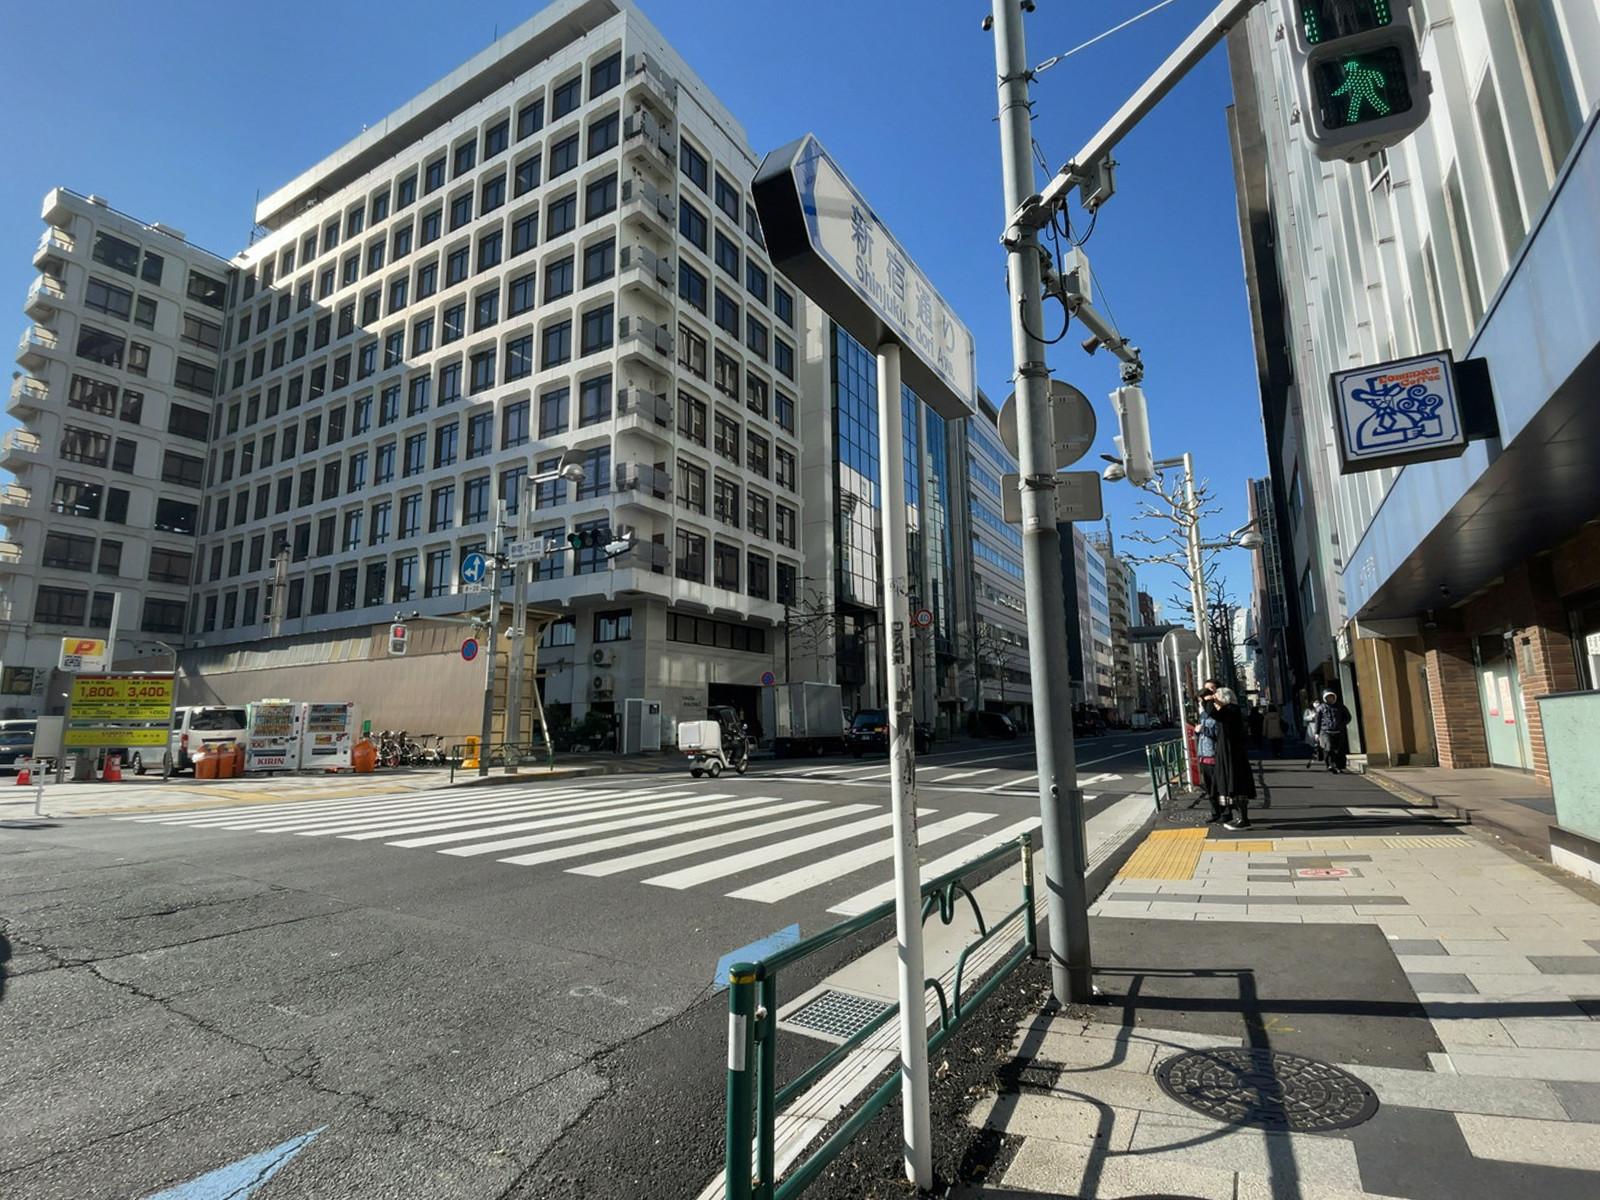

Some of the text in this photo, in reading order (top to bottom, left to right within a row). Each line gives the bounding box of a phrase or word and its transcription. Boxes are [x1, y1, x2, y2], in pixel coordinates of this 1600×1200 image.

[850, 204, 956, 355] 新宿通り
[1401, 375, 1439, 386] Coffee
[919, 613, 929, 623] 40
[73, 640, 95, 655] P
[257, 757, 285, 765] KIRIN
